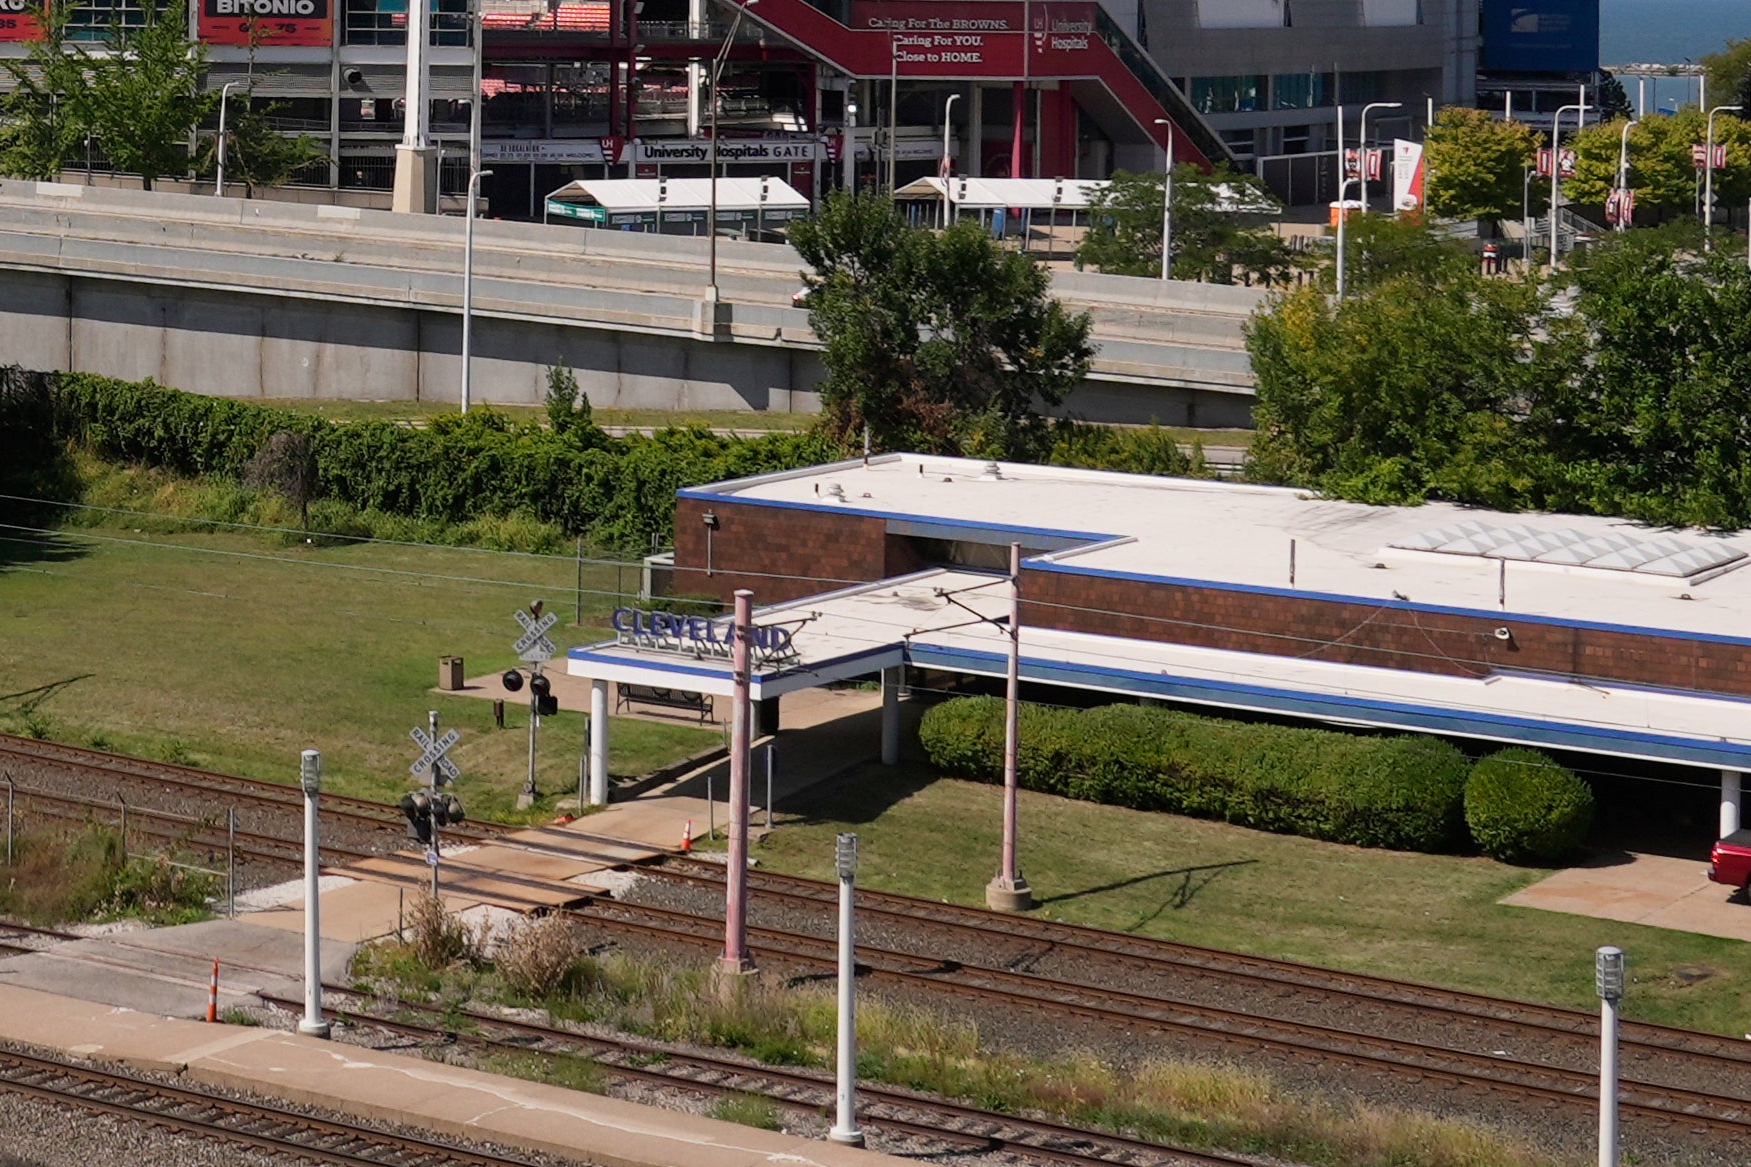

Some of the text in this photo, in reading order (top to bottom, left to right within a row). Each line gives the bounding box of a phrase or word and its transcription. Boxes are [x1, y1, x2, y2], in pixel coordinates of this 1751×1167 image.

[274, 23, 298, 34] 75
[868, 17, 1009, 31] Caing For The BROWNS.
[1052, 19, 1093, 36] University
[934, 36, 953, 46] For
[954, 36, 984, 46] YOU.
[1051, 36, 1089, 52] Hospitals
[927, 53, 939, 62] to
[941, 53, 983, 63] HOME.
[644, 145, 708, 161] University
[773, 146, 808, 158] GATE
[516, 612, 532, 630] RAIL
[515, 616, 555, 650] CROSSING
[412, 728, 458, 778] RAIL ROAD
[413, 732, 456, 773] CROSSING
